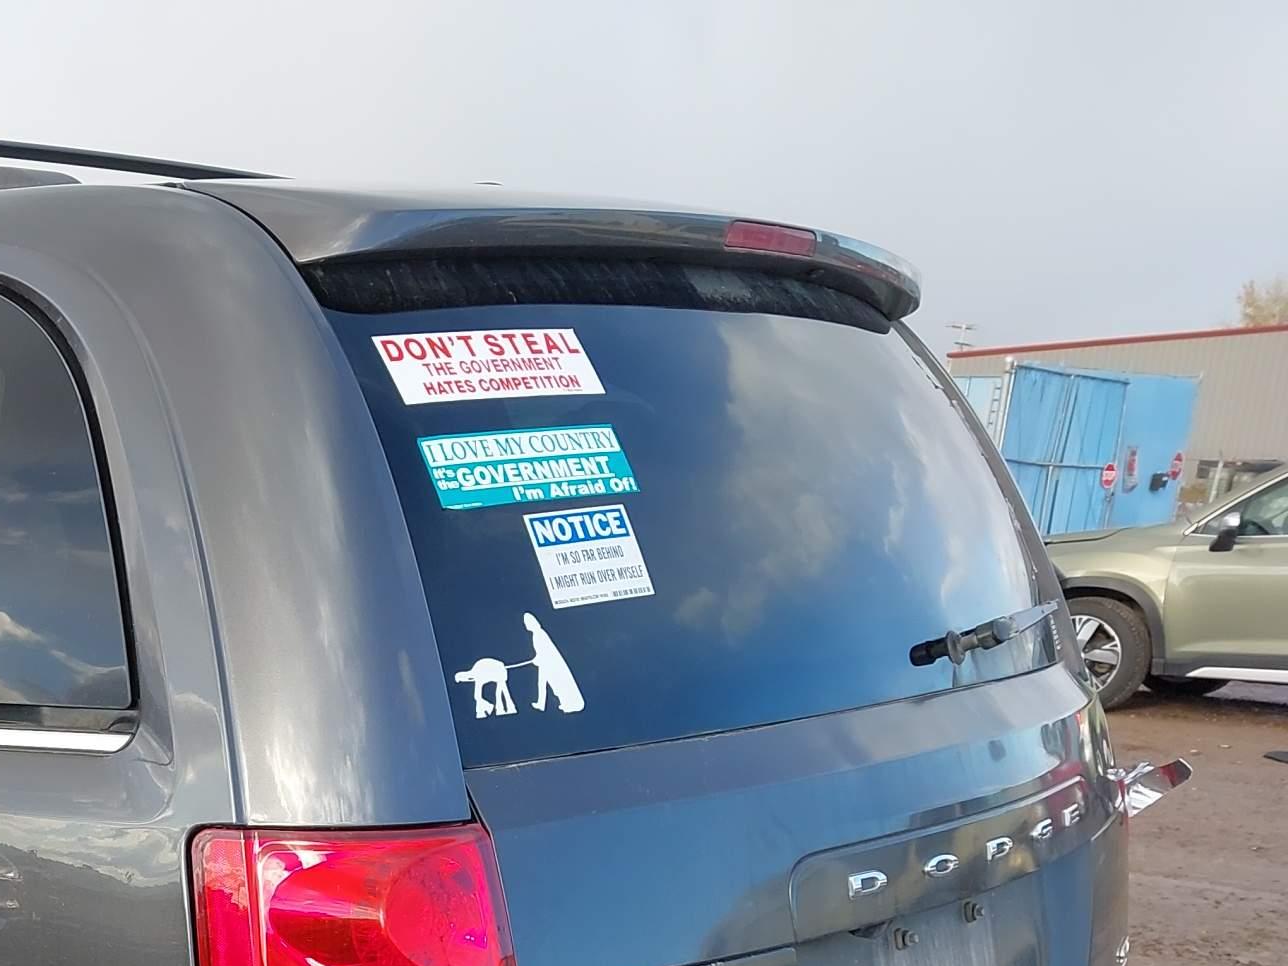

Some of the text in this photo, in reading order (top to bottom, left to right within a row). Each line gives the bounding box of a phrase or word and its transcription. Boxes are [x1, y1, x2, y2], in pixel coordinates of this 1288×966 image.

[380, 332, 580, 362] DON'T STEAL
[422, 357, 563, 377] THE GOVERNMENT
[423, 374, 582, 396] HATES COMPETITION
[426, 430, 616, 463] I LOVE MY COUNTRY
[456, 456, 610, 487] GOVERNMENT
[437, 479, 459, 490] the
[512, 485, 545, 501] I'm
[550, 480, 606, 498] Afraid
[532, 511, 627, 544] NOTICE
[555, 545, 624, 566] I'M SO FAR BEHIND
[554, 573, 579, 589] MIGHT
[579, 571, 596, 585] RUN
[596, 568, 616, 583] OVER
[617, 565, 644, 580] MYSELF
[847, 803, 1082, 900] DODGE
